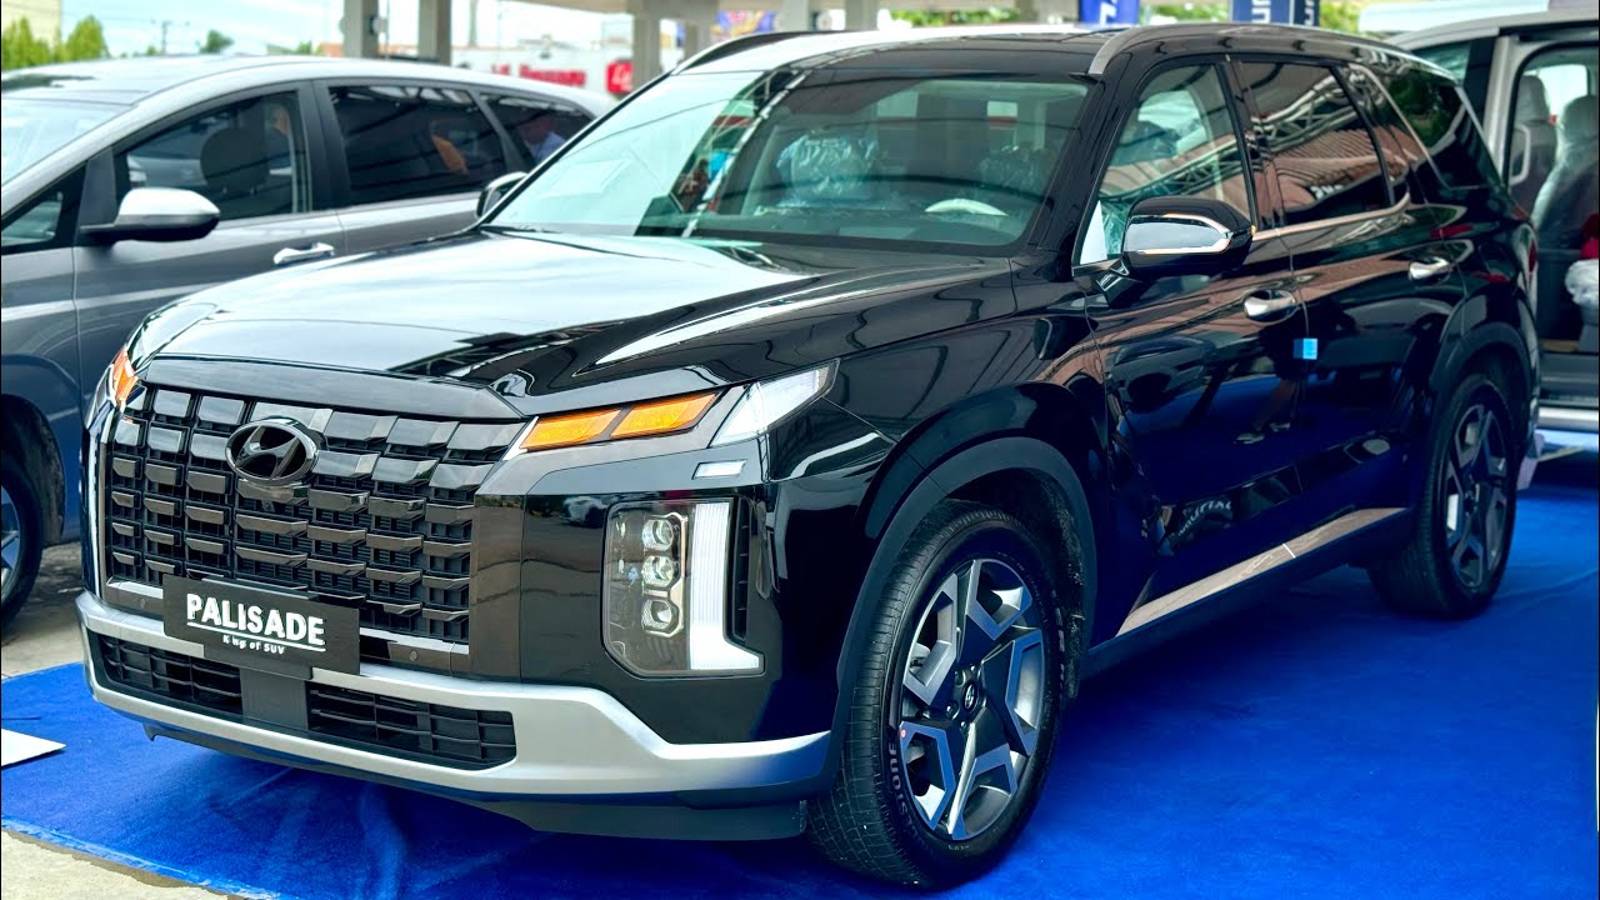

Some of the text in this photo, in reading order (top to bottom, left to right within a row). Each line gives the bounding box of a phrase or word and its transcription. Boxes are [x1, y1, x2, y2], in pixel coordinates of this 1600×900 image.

[186, 593, 326, 646] PALISADE
[249, 641, 261, 651] of
[263, 643, 285, 655] SUV
